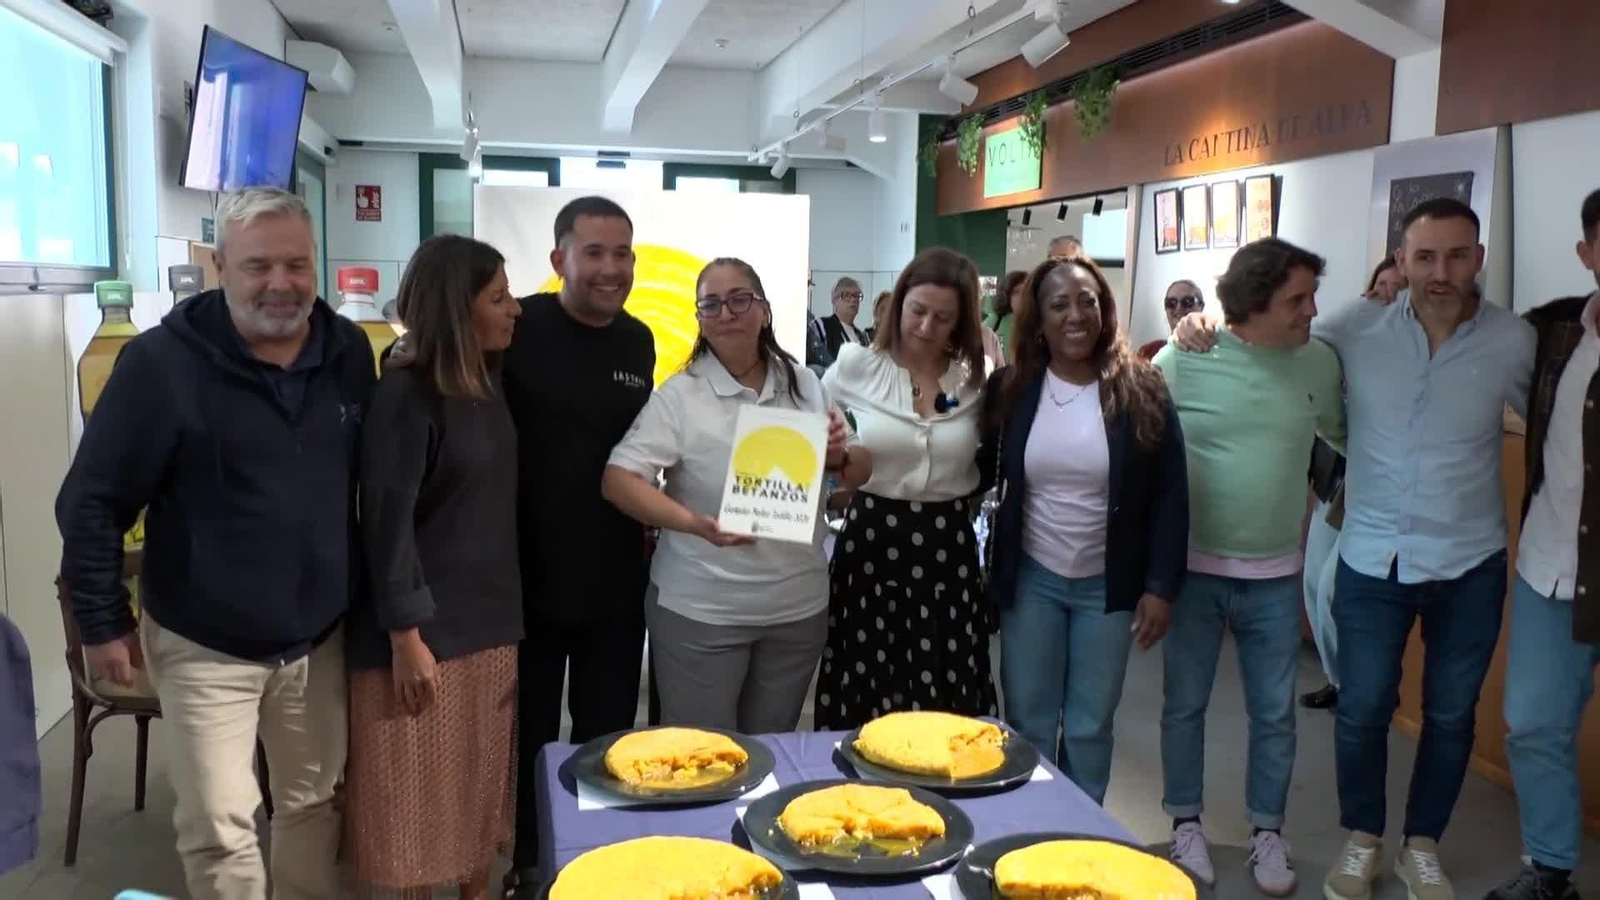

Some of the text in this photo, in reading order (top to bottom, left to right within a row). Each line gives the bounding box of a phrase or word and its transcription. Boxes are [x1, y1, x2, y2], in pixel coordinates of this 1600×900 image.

[1163, 143, 1184, 167] LA
[1188, 122, 1271, 162] CANTINA
[732, 484, 808, 504] BETANZOS
[734, 475, 805, 493] TORTILLA
